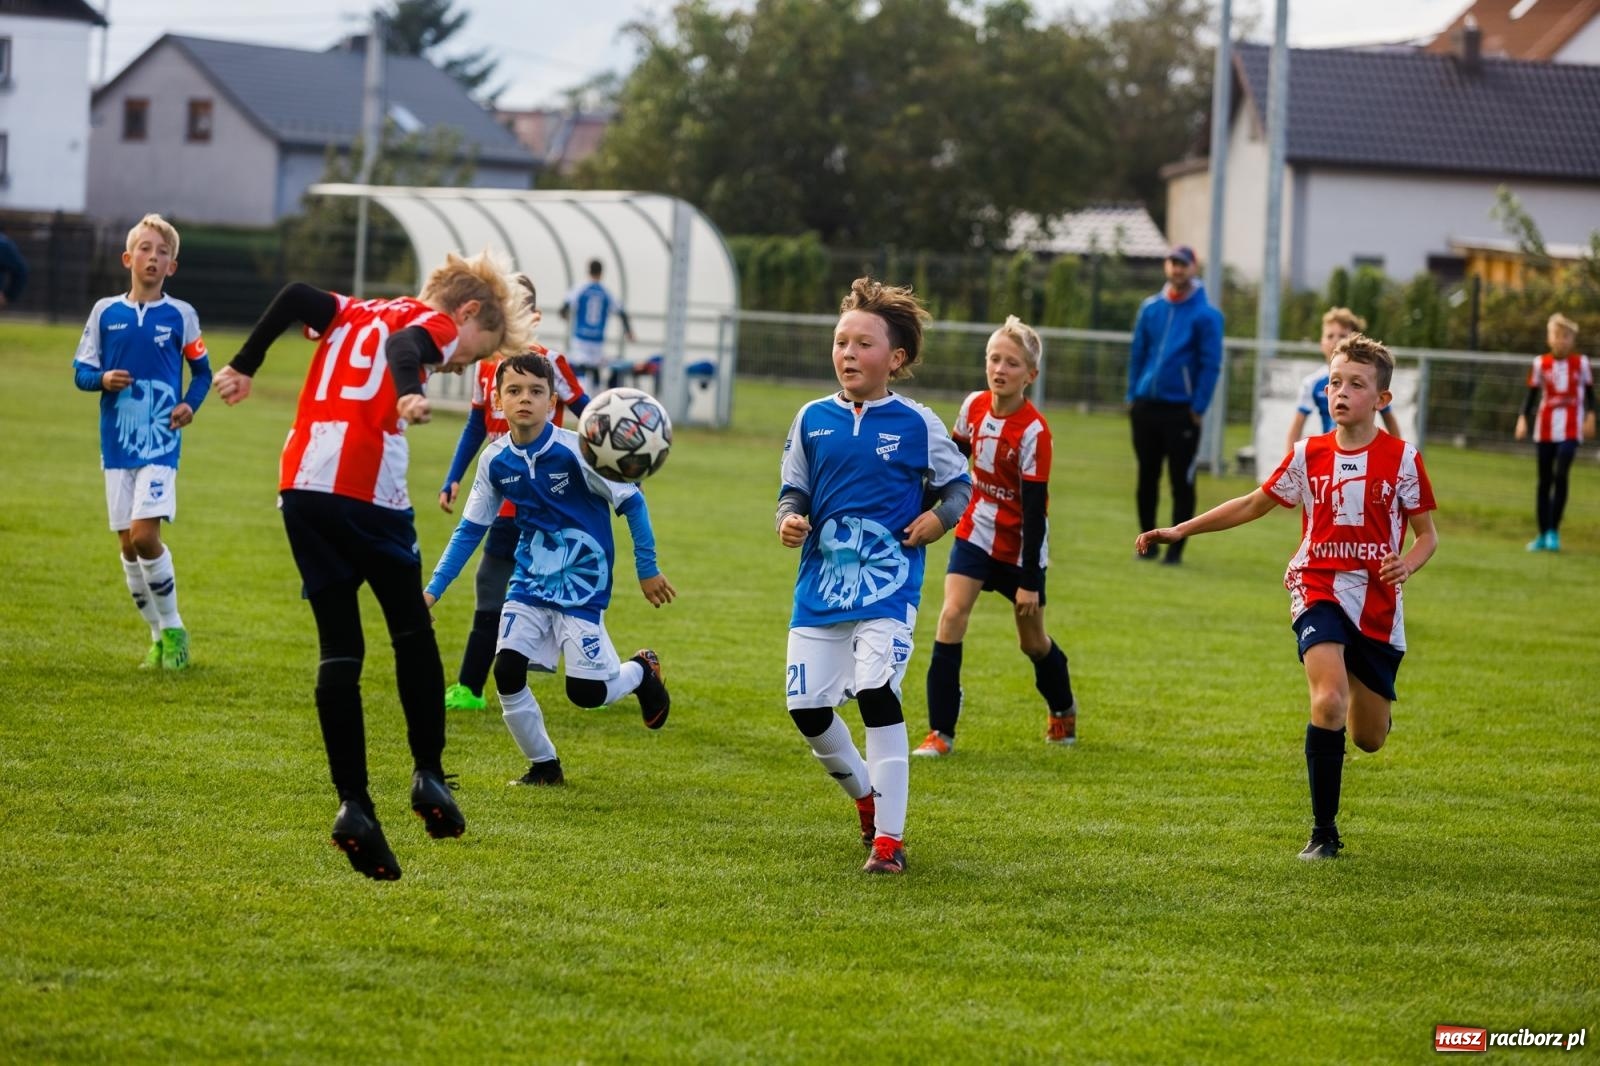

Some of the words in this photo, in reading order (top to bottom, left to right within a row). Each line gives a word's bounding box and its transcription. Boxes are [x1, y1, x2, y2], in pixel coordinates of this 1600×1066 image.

[315, 317, 389, 401] 19
[1310, 475, 1330, 504] 17
[1312, 541, 1388, 561] WINNERS
[503, 612, 516, 639] 7
[787, 663, 806, 696] 21
